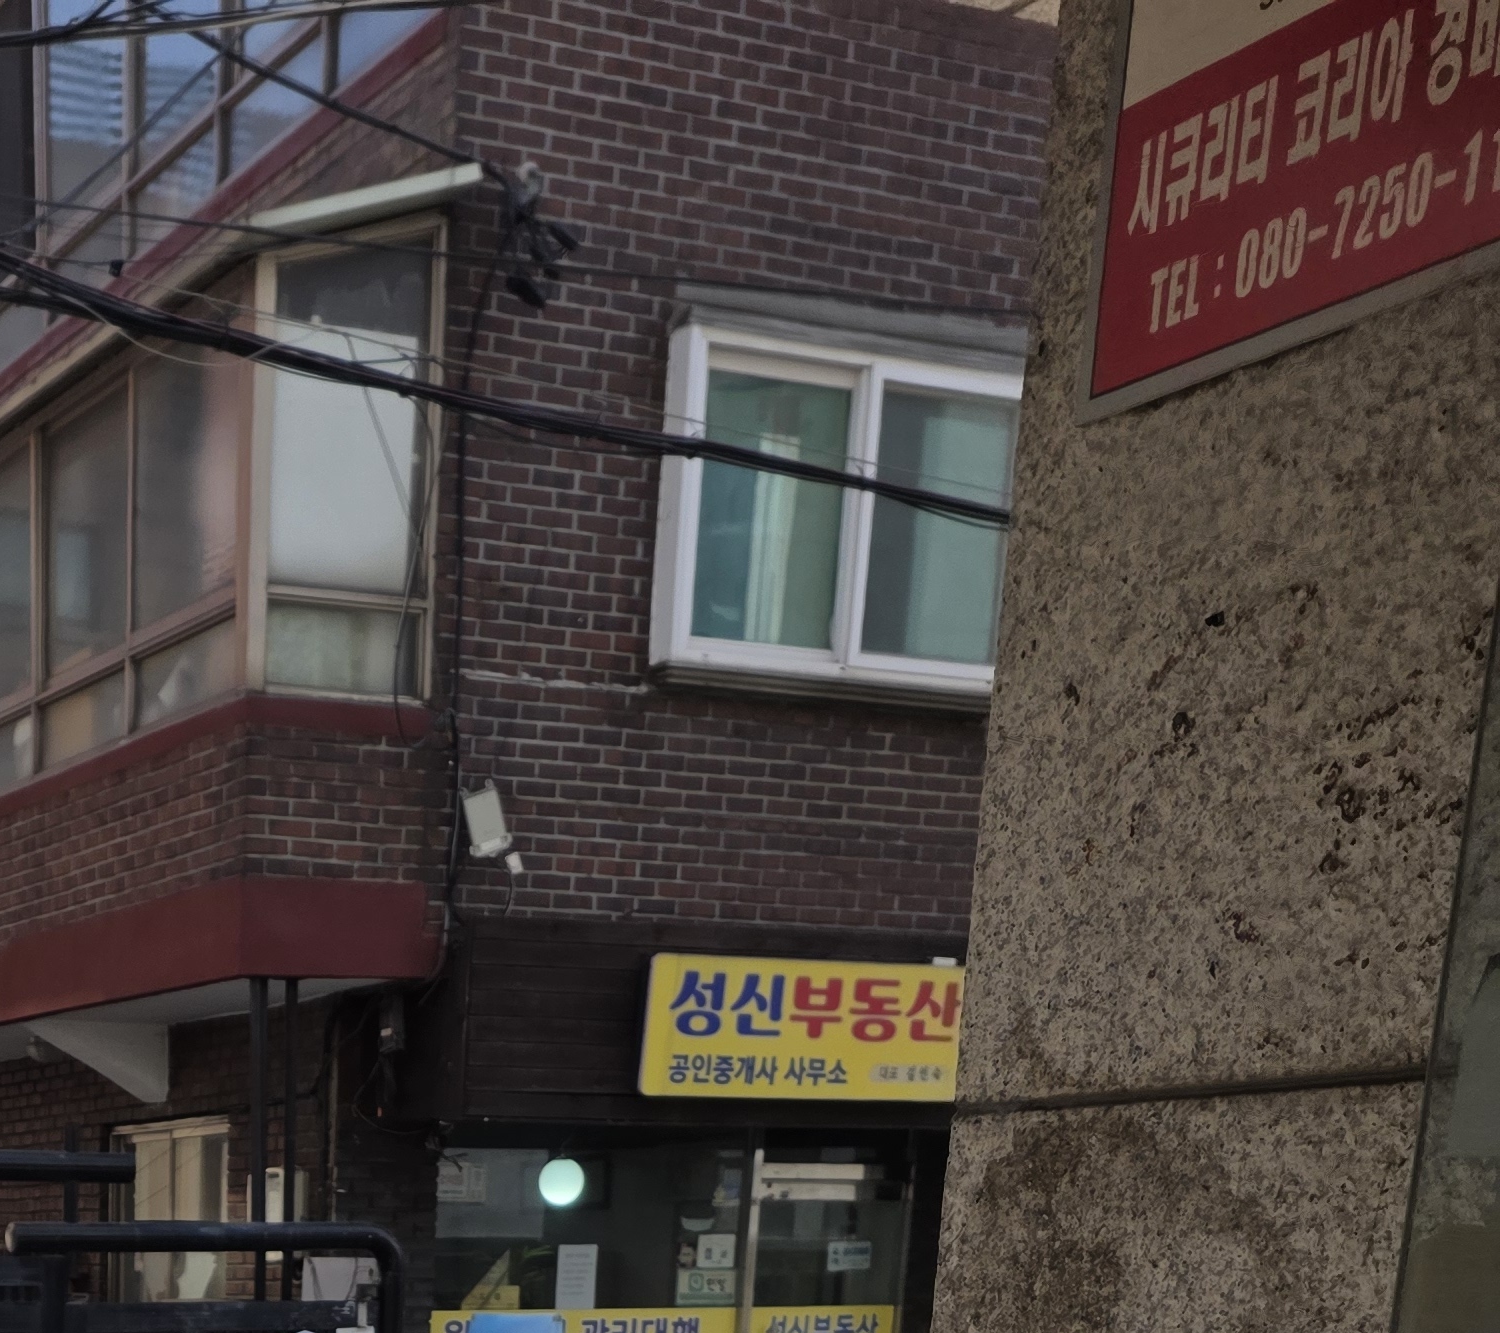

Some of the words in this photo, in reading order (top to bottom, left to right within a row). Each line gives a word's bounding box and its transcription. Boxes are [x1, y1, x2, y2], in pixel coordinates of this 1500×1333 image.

[1127, 74, 1279, 236] 시큐리티
[1287, 9, 1415, 166] 코리아
[669, 970, 961, 1043] 성신부동산
[668, 1054, 778, 1085] 공인중개사
[784, 1057, 848, 1086] 사무소
